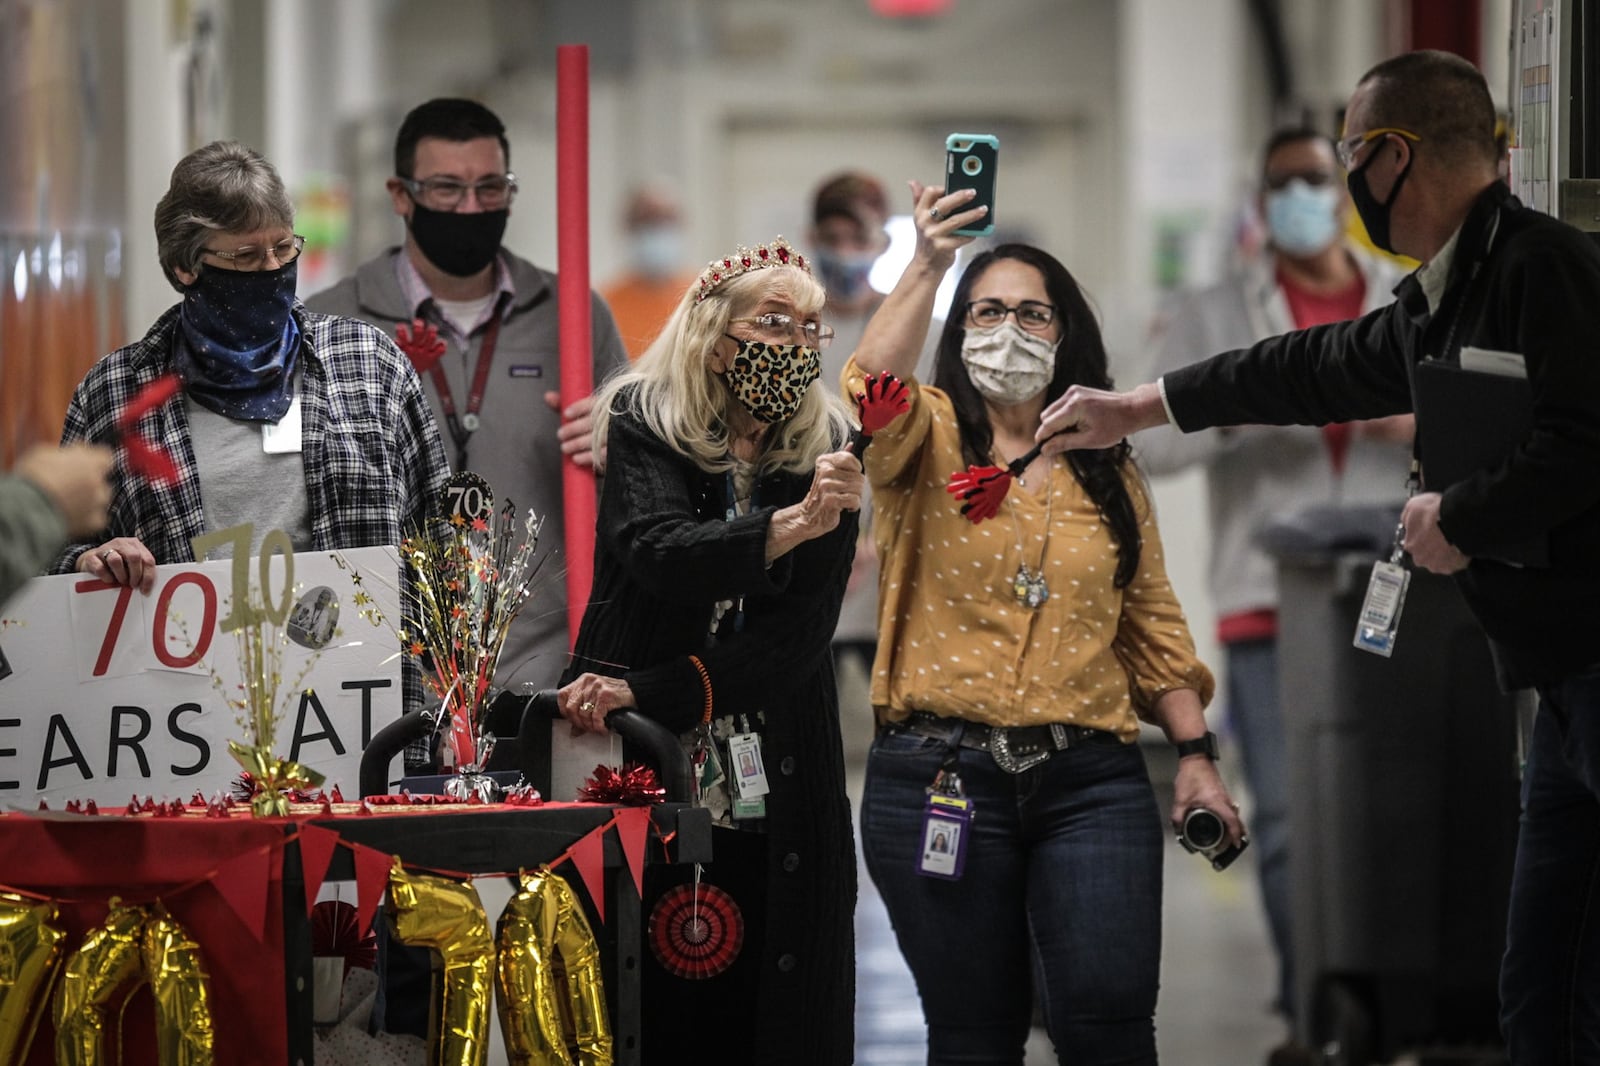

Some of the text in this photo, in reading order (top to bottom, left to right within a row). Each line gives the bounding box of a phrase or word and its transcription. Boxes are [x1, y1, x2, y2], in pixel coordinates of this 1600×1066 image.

[447, 486, 484, 519] 70
[75, 571, 218, 677] 70
[191, 522, 294, 634] 70
[288, 679, 392, 763] AT
